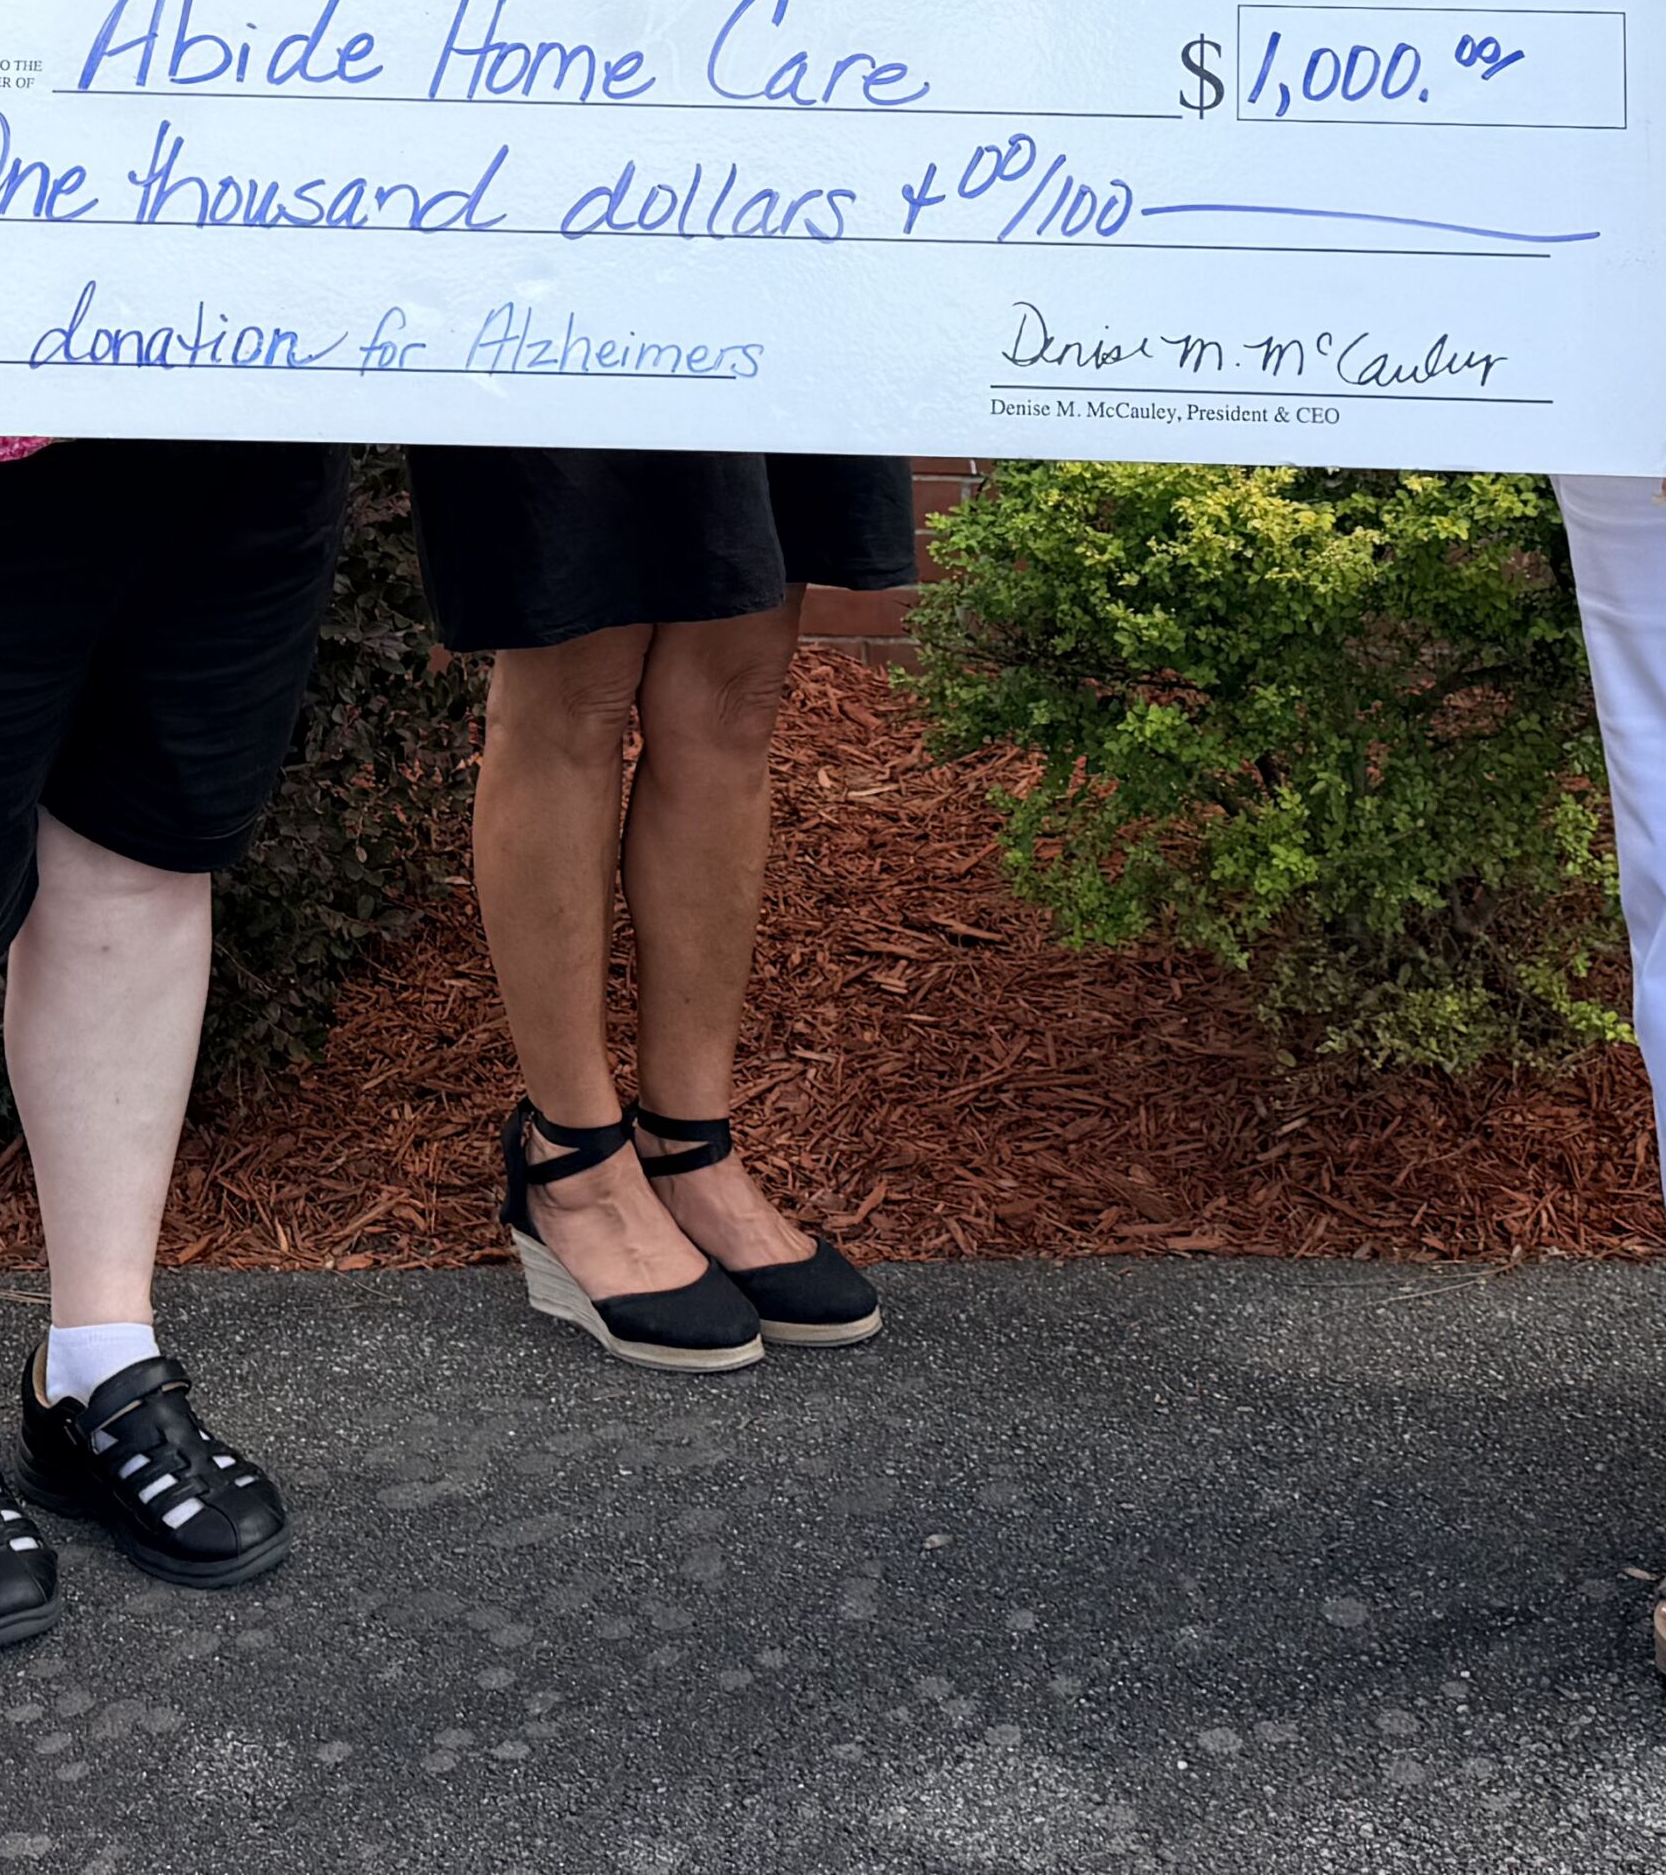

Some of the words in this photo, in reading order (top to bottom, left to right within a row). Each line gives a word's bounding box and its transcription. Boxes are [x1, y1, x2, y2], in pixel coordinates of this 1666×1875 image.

[13, 59, 43, 72] THE
[15, 76, 36, 89] OF
[127, 119, 509, 234] thousand
[564, 160, 854, 241] dollars
[28, 279, 349, 371] donation
[359, 305, 427, 377] for
[464, 300, 766, 379] Alzheimers
[1001, 301, 1154, 367] Denise
[1159, 333, 1242, 373] M.
[990, 398, 1051, 417] Denise
[1055, 400, 1082, 417] M.
[1086, 401, 1183, 424] McCauley,
[1186, 403, 1269, 423] President
[1273, 406, 1290, 423] &
[1295, 406, 1341, 424] CEO
